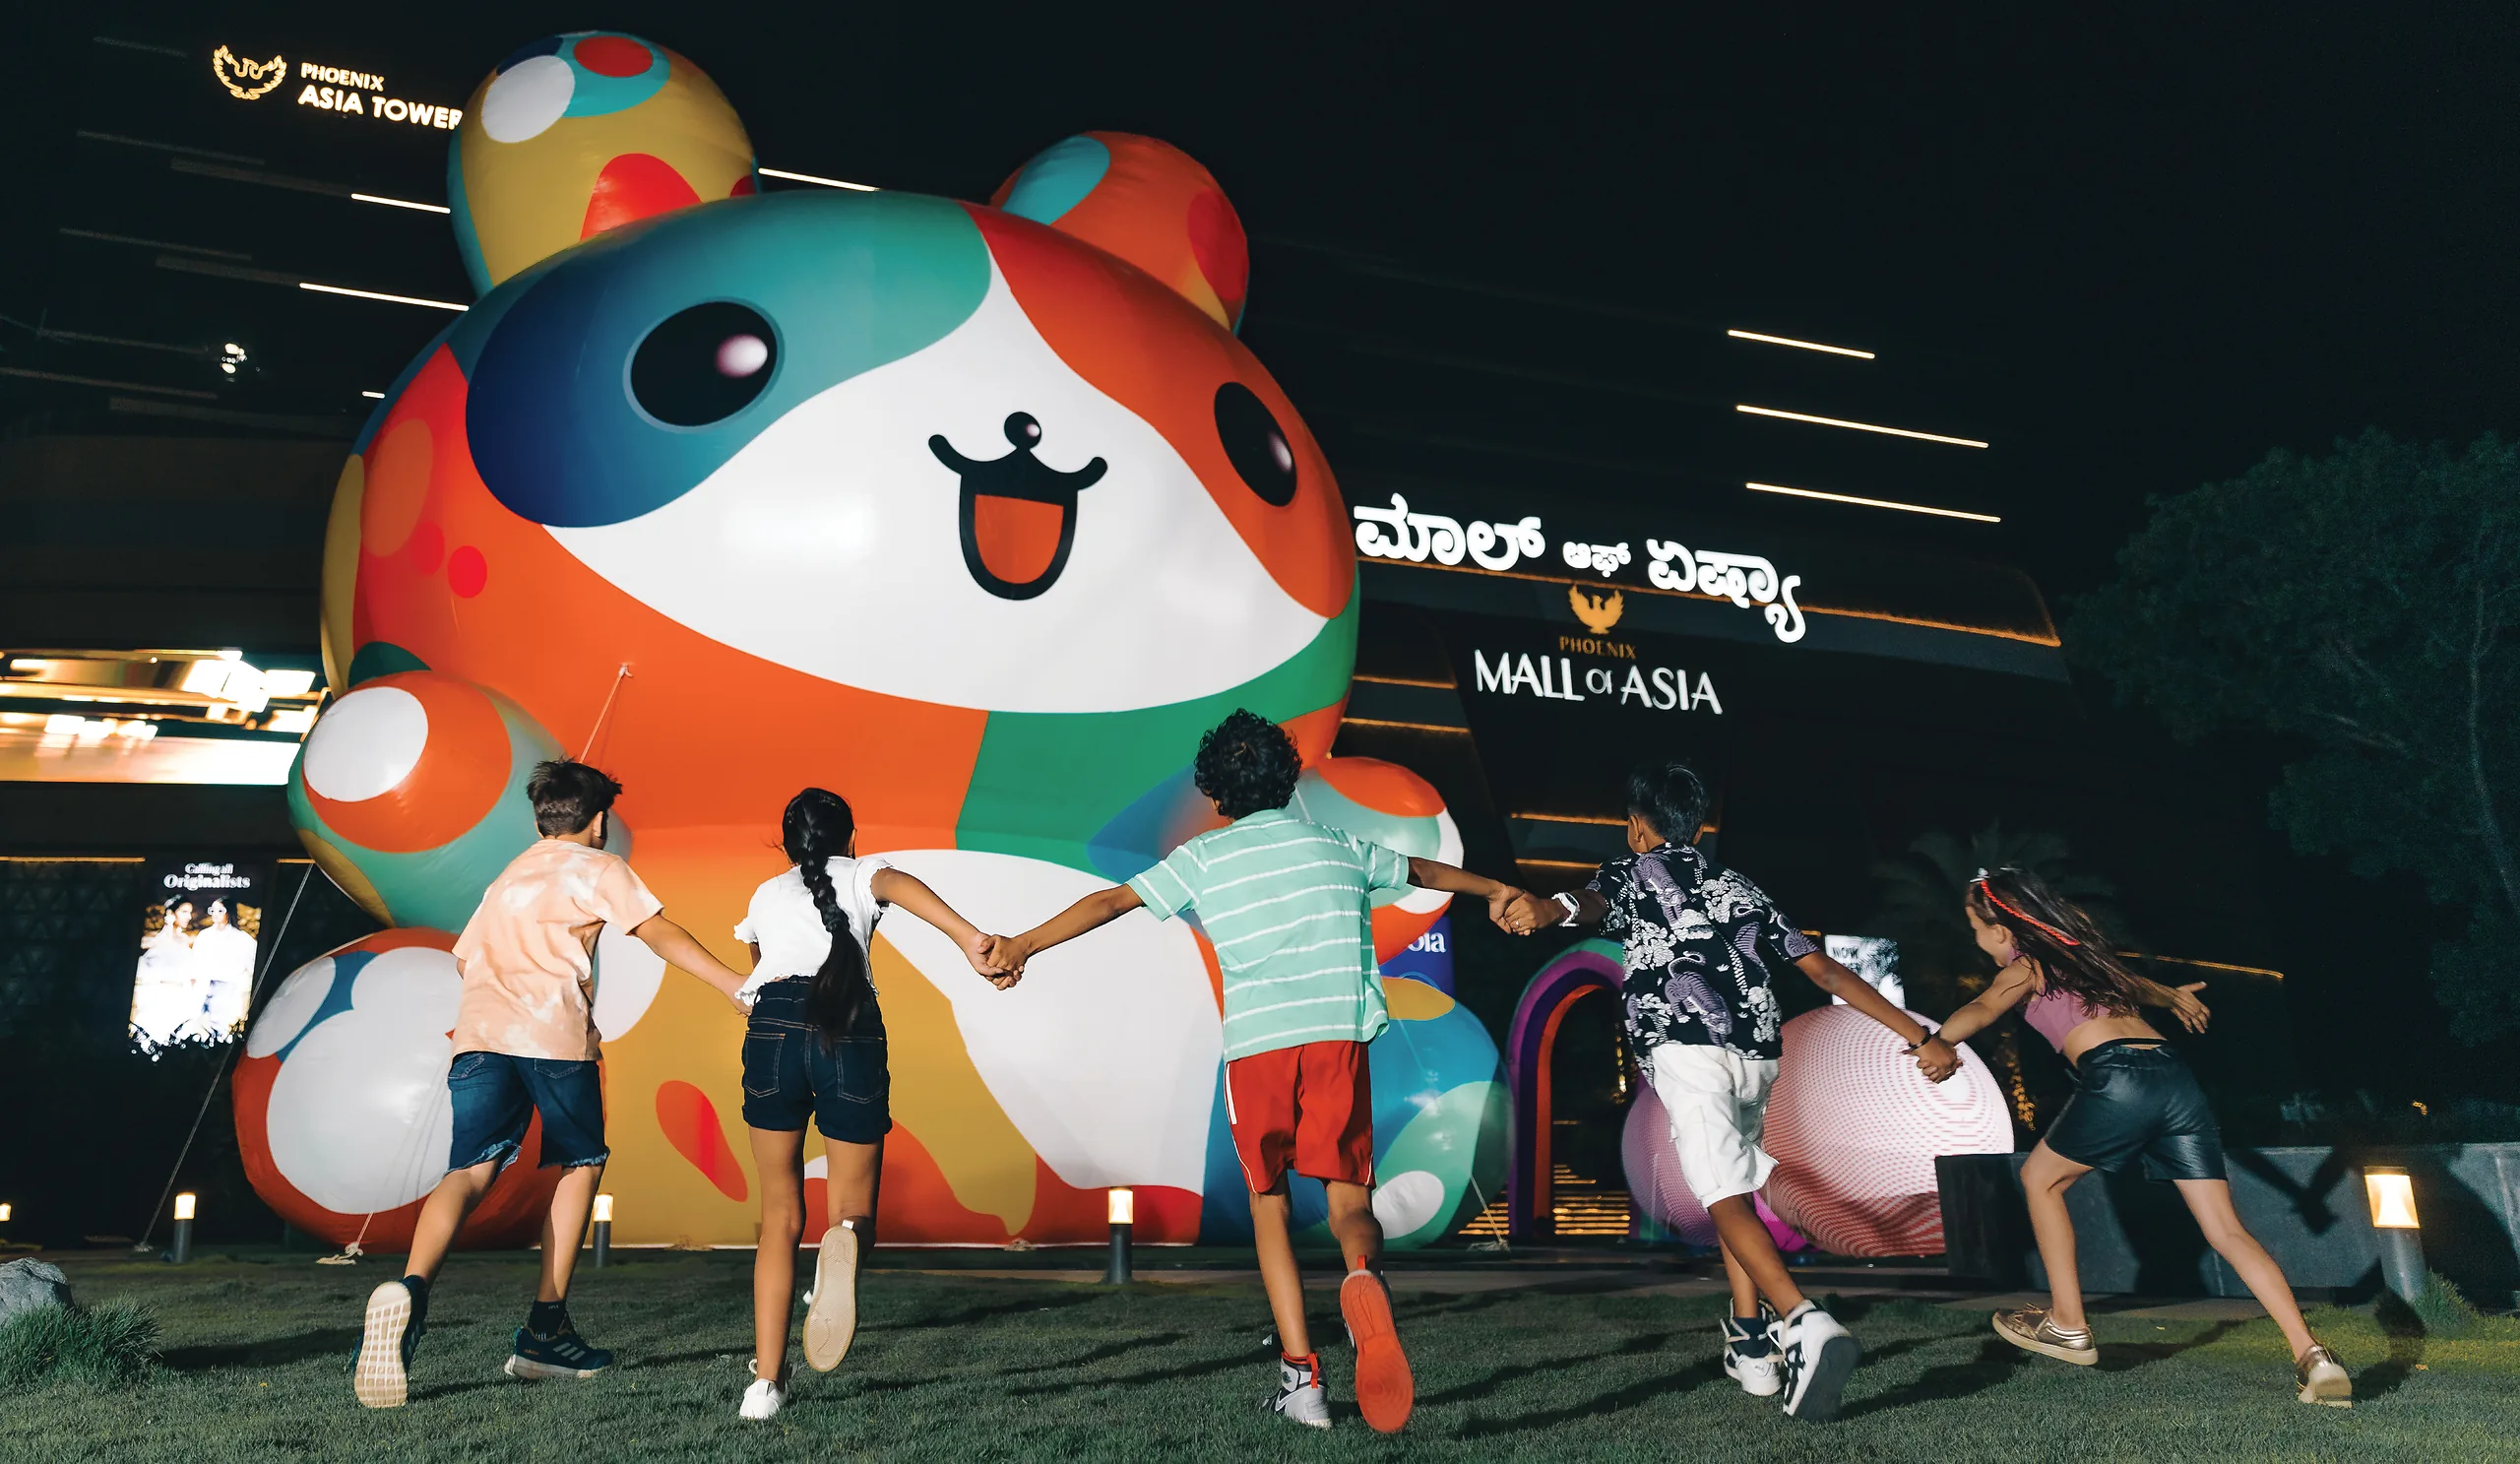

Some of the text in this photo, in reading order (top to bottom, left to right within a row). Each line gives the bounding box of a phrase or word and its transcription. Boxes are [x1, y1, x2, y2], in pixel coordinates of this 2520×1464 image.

[300, 62, 385, 92] PHOENIX
[297, 85, 364, 114] ASIA
[1354, 492, 1546, 571] ಮಾಲ್
[1559, 635, 1637, 660] PHOENIX
[1475, 649, 1586, 702] MALL
[1619, 665, 1724, 715] ASIA
[163, 873, 251, 891] Originalists
[184, 862, 234, 876] Calling all
